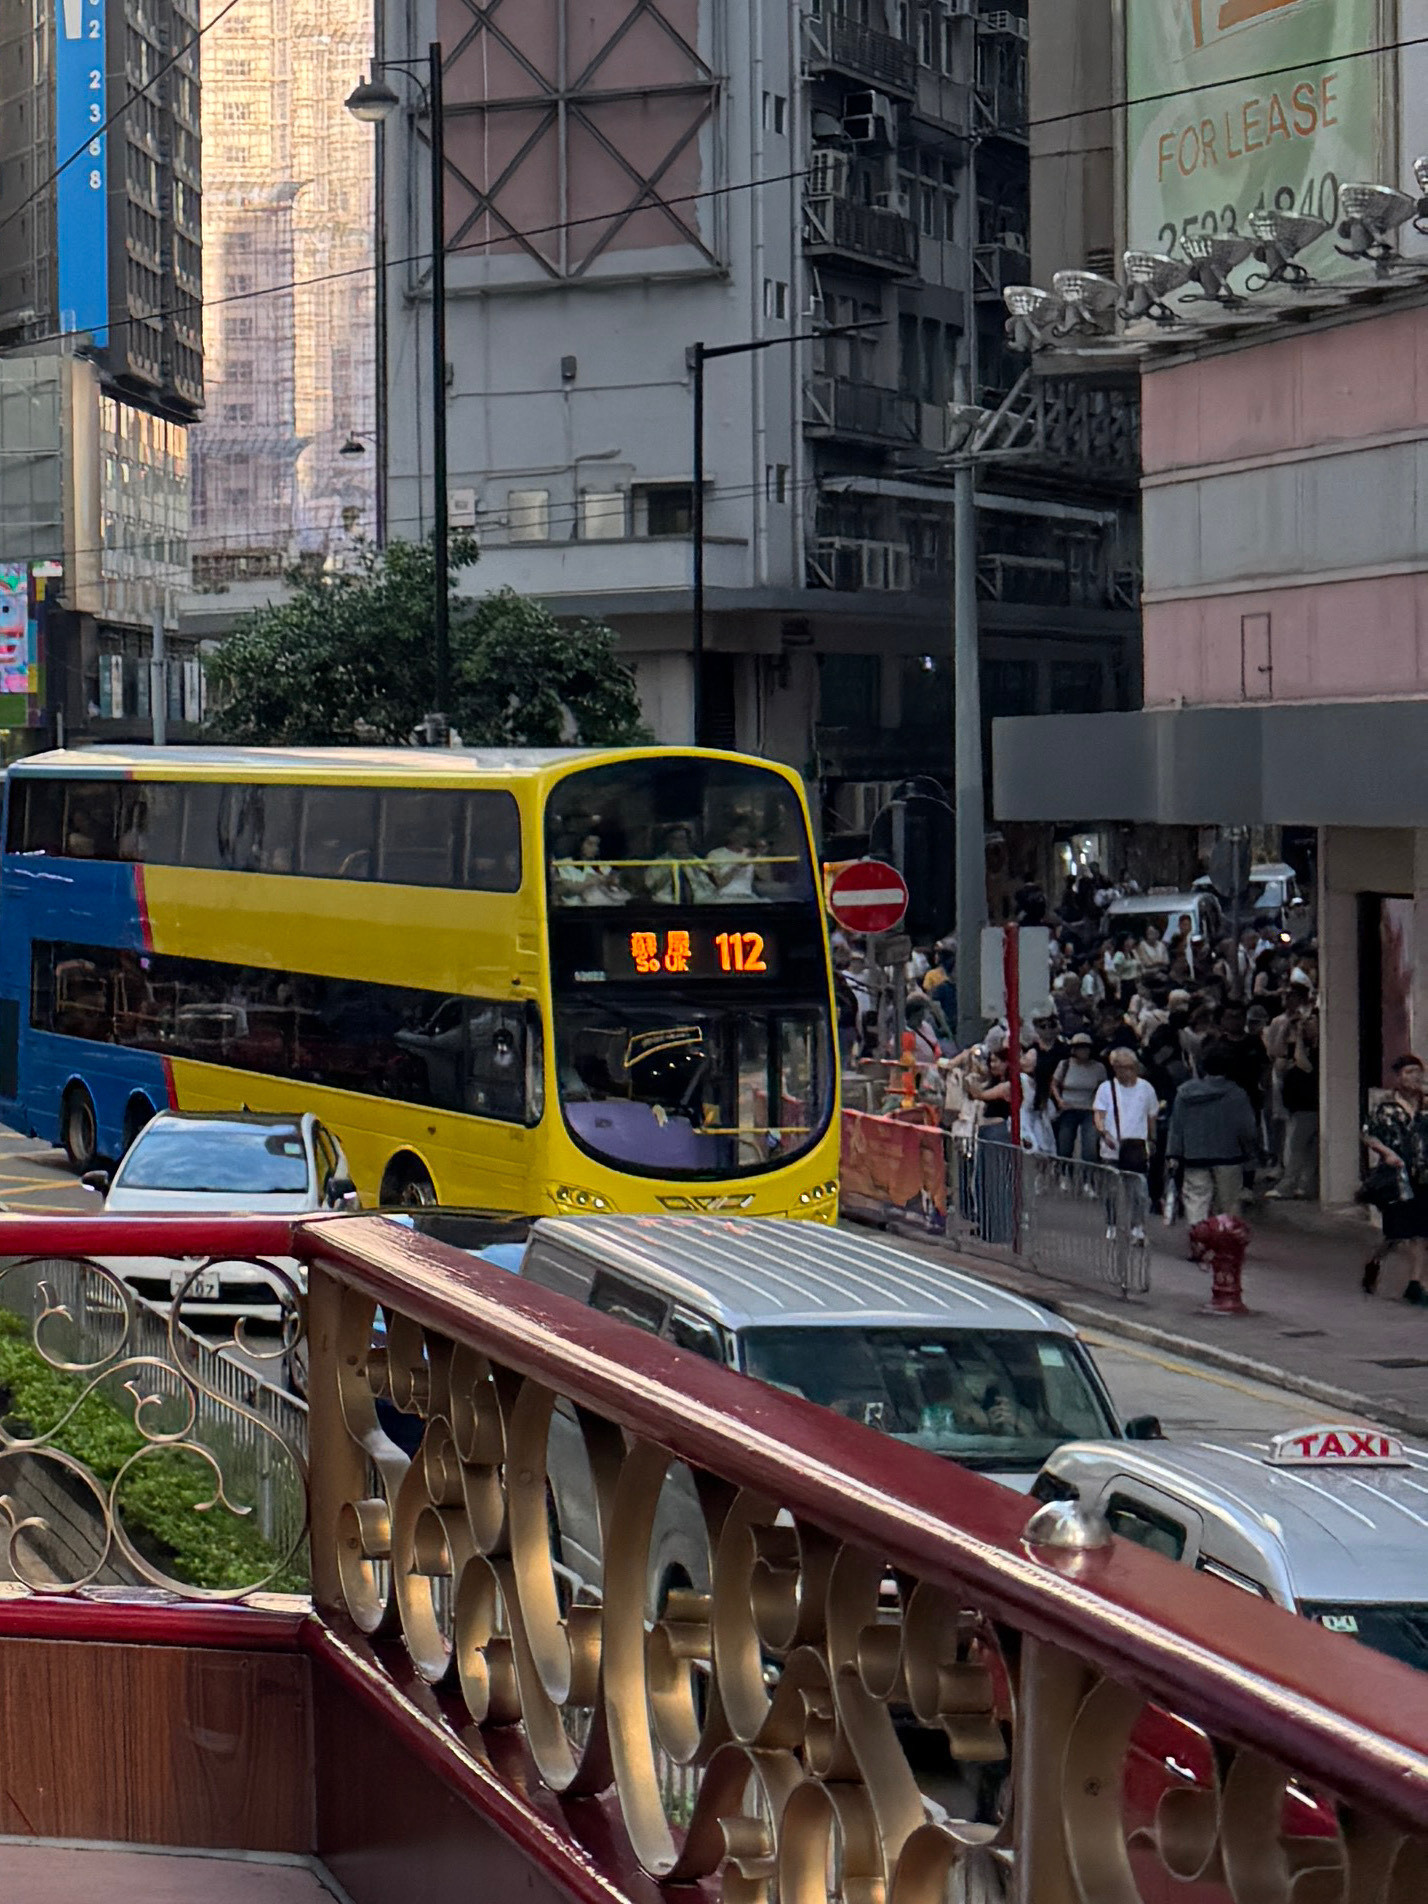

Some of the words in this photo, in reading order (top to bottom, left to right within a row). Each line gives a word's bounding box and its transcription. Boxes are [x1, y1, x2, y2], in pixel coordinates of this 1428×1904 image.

[88, 69, 101, 189] 2388
[1157, 117, 1219, 183] FOR
[1225, 72, 1340, 159] LEASE
[635, 955, 661, 973] So
[664, 953, 690, 973] Uk
[715, 931, 767, 972] 112
[1293, 1432, 1390, 1458] TAXI
